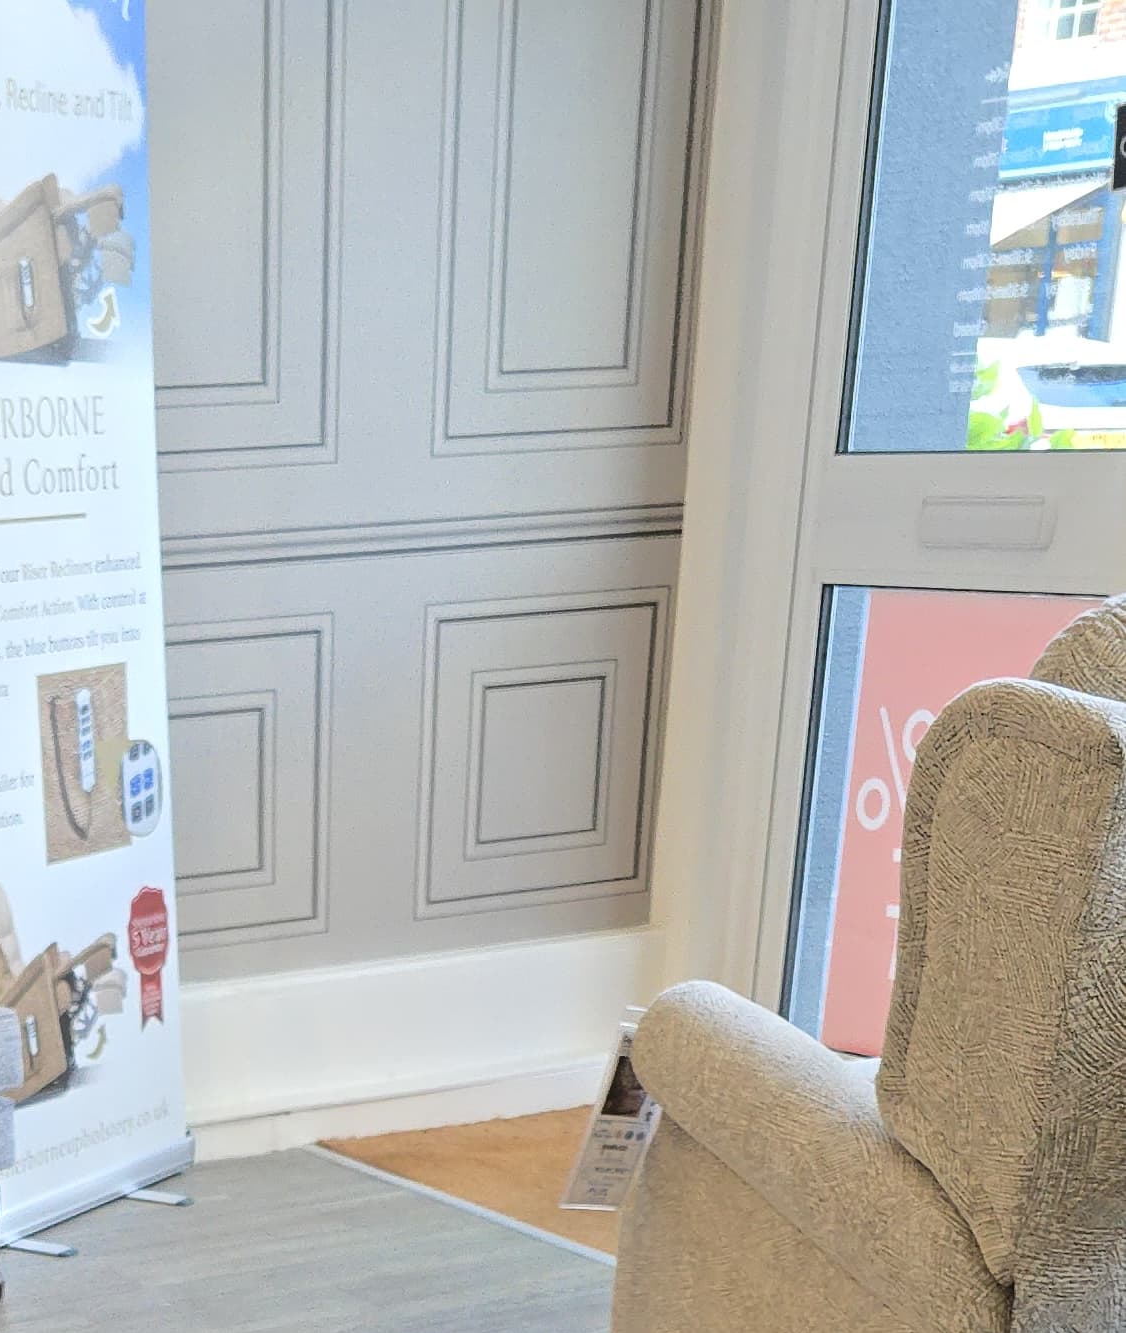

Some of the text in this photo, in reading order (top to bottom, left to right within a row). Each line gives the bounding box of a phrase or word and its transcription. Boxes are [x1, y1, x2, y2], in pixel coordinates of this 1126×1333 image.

[5, 77, 69, 117] Recline
[73, 88, 105, 119] and
[24, 453, 121, 495] Comfort
